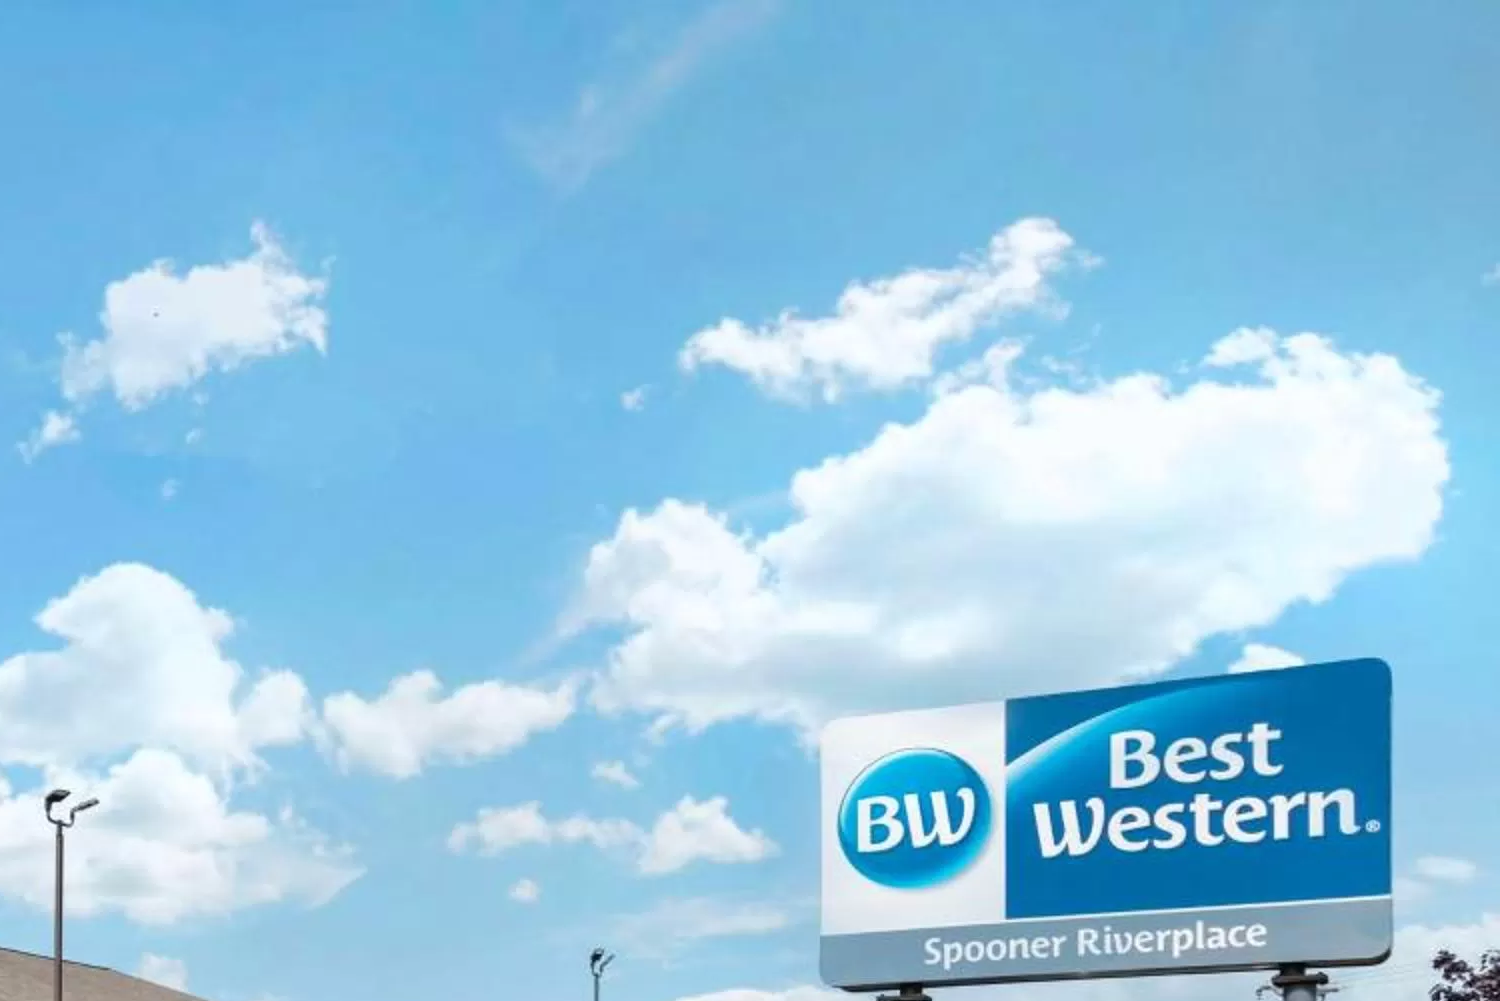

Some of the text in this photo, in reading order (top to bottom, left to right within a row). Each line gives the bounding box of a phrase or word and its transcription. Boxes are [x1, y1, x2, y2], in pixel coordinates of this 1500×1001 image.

[1109, 722, 1284, 790] Best
[856, 786, 976, 853] BW
[924, 920, 1268, 970] Spooner Riverplace
